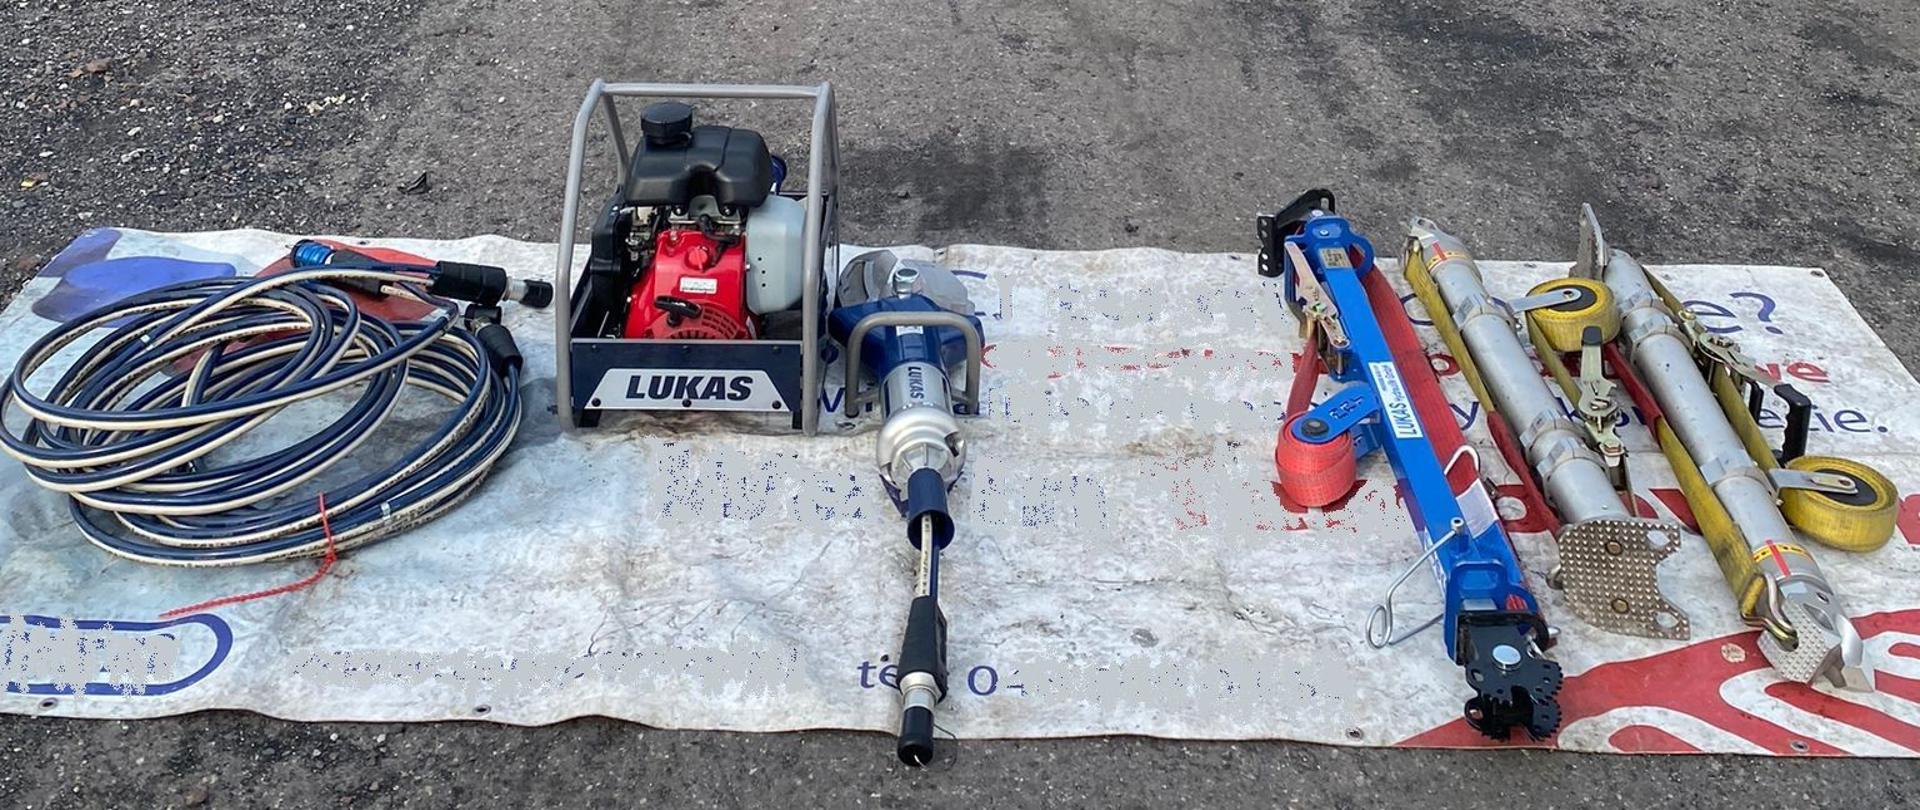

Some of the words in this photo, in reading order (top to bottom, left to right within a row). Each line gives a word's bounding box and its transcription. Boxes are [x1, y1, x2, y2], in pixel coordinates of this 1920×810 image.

[625, 375, 754, 401] LUKAS
[908, 366, 925, 399] LUKAS
[1388, 402, 1418, 435] LUKAS
